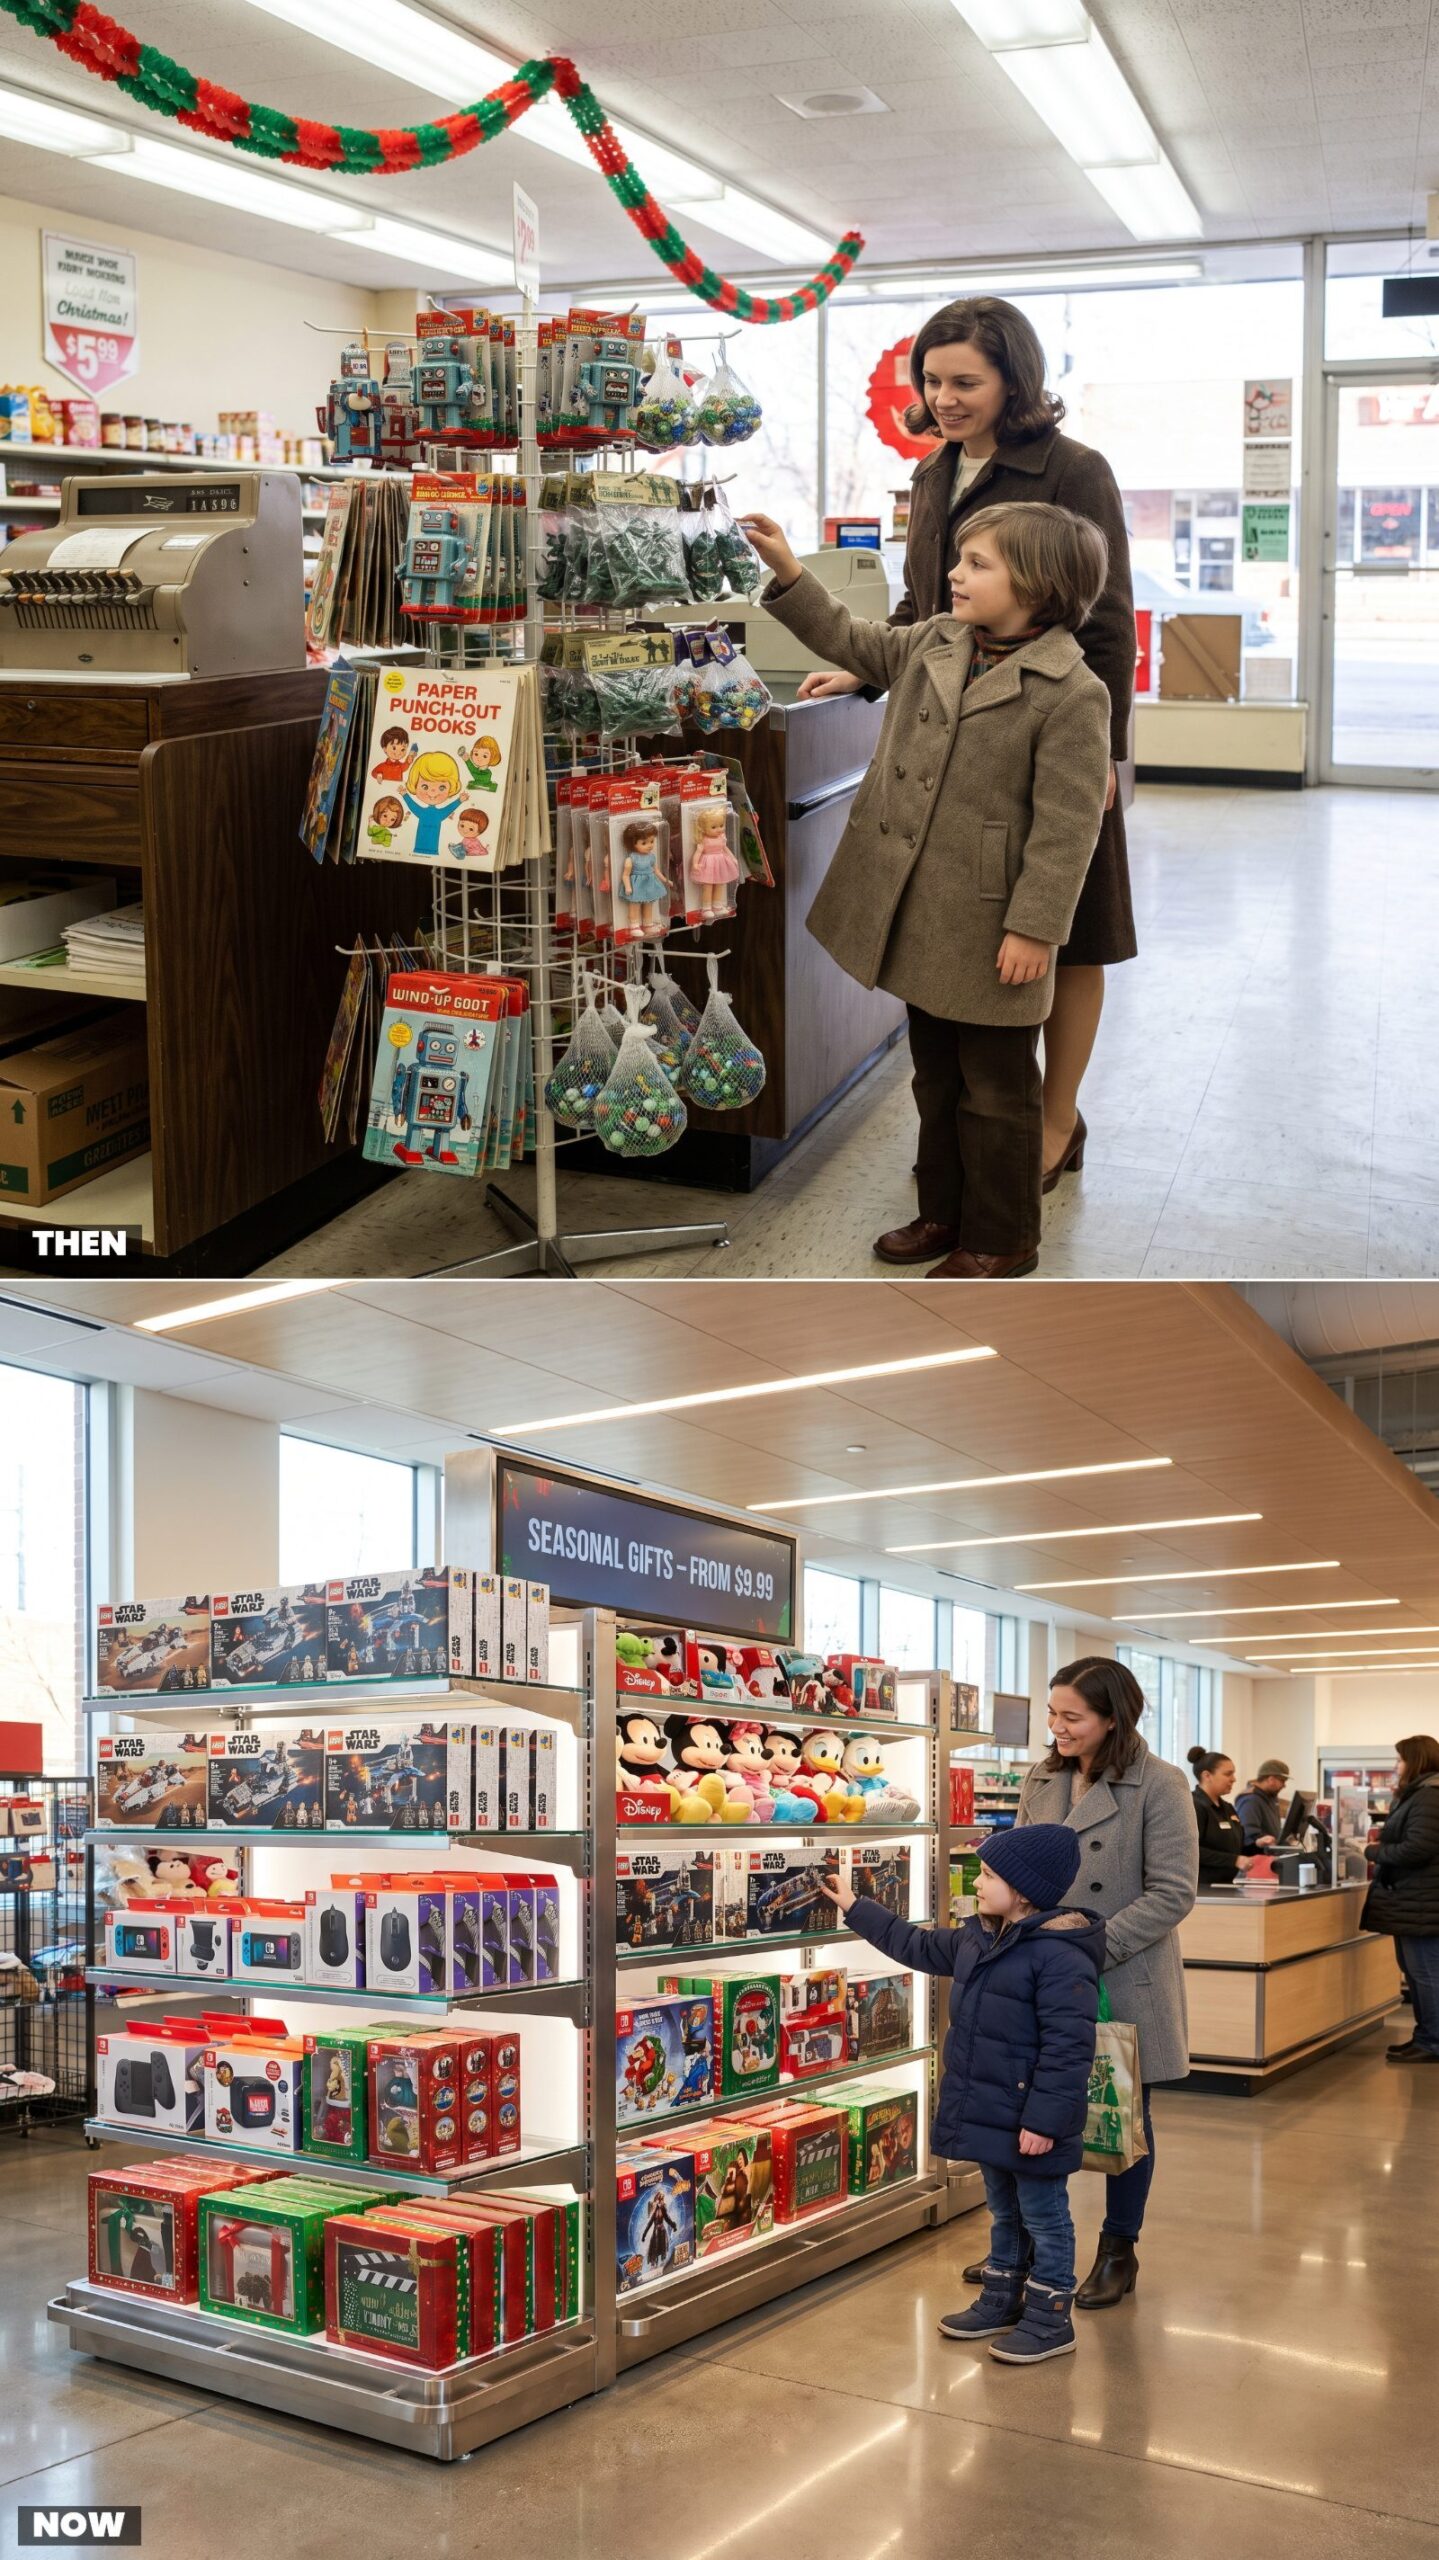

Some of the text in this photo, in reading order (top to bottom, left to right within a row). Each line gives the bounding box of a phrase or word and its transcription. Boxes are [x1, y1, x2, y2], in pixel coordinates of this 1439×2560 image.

[57, 300, 128, 326] Christmas!
[417, 682, 478, 700] PAPER
[389, 698, 502, 720] PUNCH-OUT
[410, 717, 477, 736] BOOKS
[392, 988, 452, 1006] WIND-UP
[528, 1517, 624, 1569] SEASONAL
[628, 1540, 674, 1580] GIFTS
[689, 1556, 731, 1592] FROM
[734, 1564, 774, 1601] $9.99
[346, 1577, 381, 1590] STAR
[346, 1585, 381, 1599] WARS
[231, 1593, 265, 1606] STAR
[115, 1604, 146, 1616] STAR
[231, 1602, 265, 1614] WARS
[115, 1611, 146, 1624] WARS
[227, 1735, 261, 1745] STAR
[346, 1729, 380, 1740] STAR
[114, 1738, 145, 1749] STAR
[228, 1742, 261, 1754] WARS
[345, 1737, 380, 1749] WARS
[115, 1746, 145, 1757] WARS
[762, 1853, 786, 1861] STAR
[861, 1849, 880, 1857] STAR
[631, 1855, 661, 1866] STAR
[762, 1860, 786, 1870] WARS
[862, 1855, 880, 1864] WARS
[632, 1864, 661, 1875] WARS
